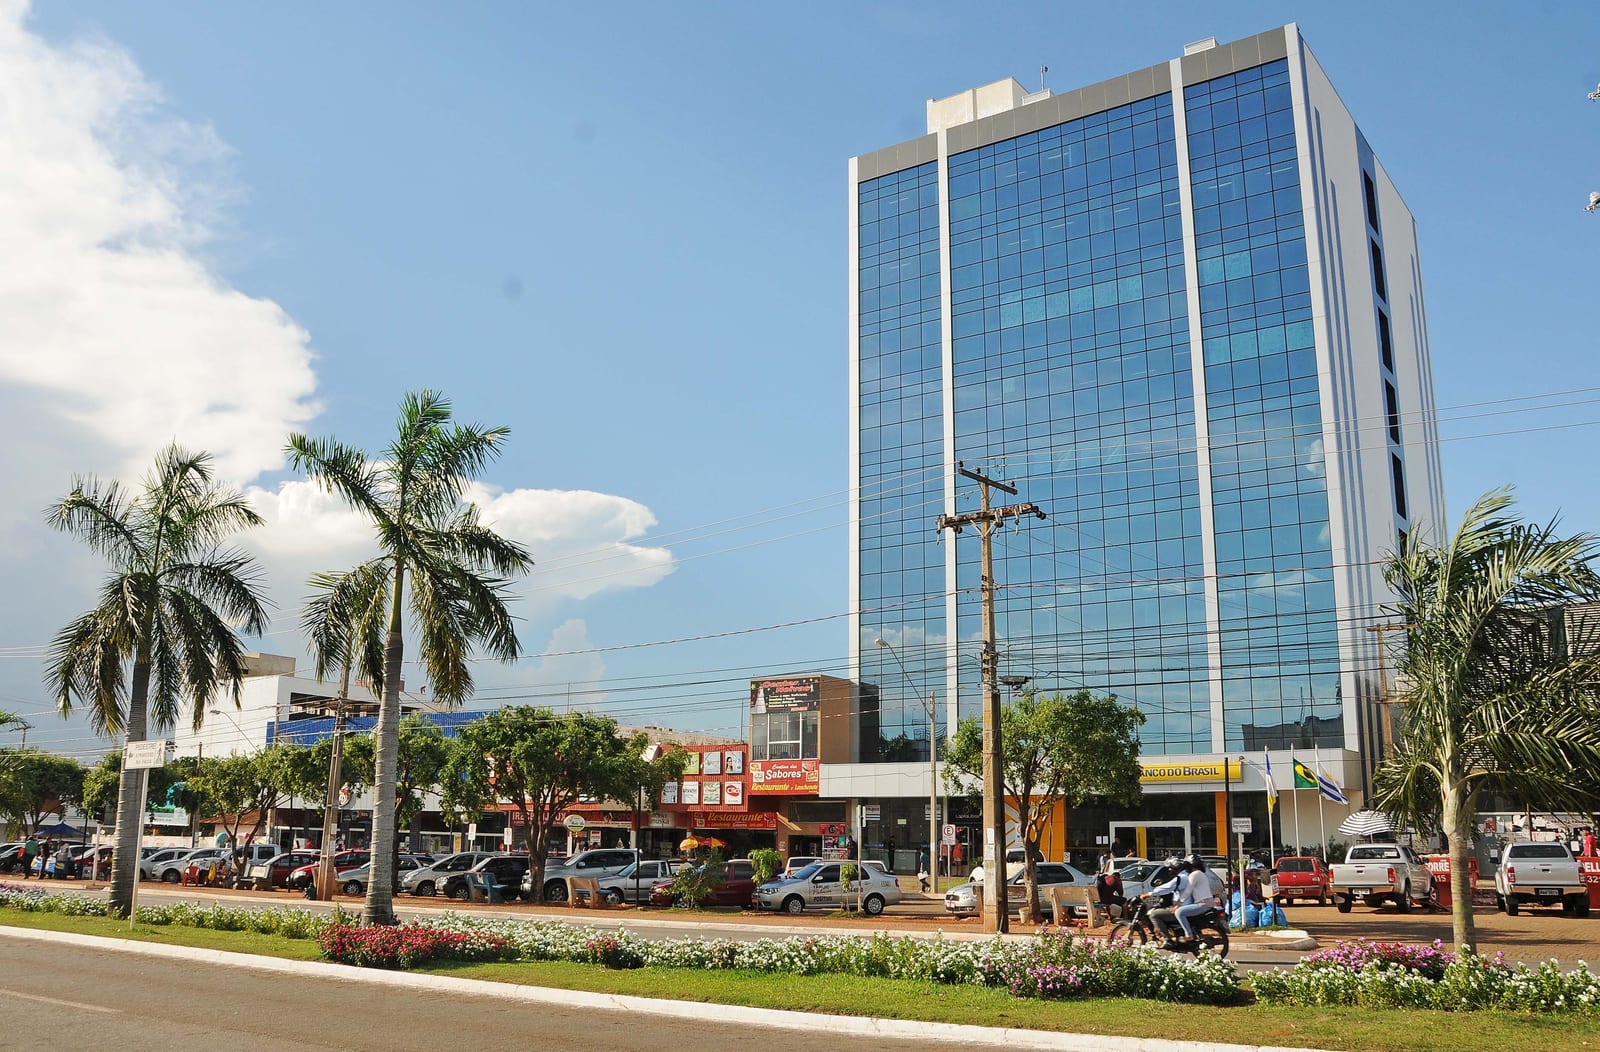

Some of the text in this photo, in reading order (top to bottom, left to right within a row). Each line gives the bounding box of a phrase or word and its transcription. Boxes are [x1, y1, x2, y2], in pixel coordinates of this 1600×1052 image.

[765, 769, 802, 780] Sabores
[1139, 766, 1219, 777] ANCO DO BRASIL
[751, 782, 790, 791] Restaurante
[707, 811, 763, 822] Restaurante
